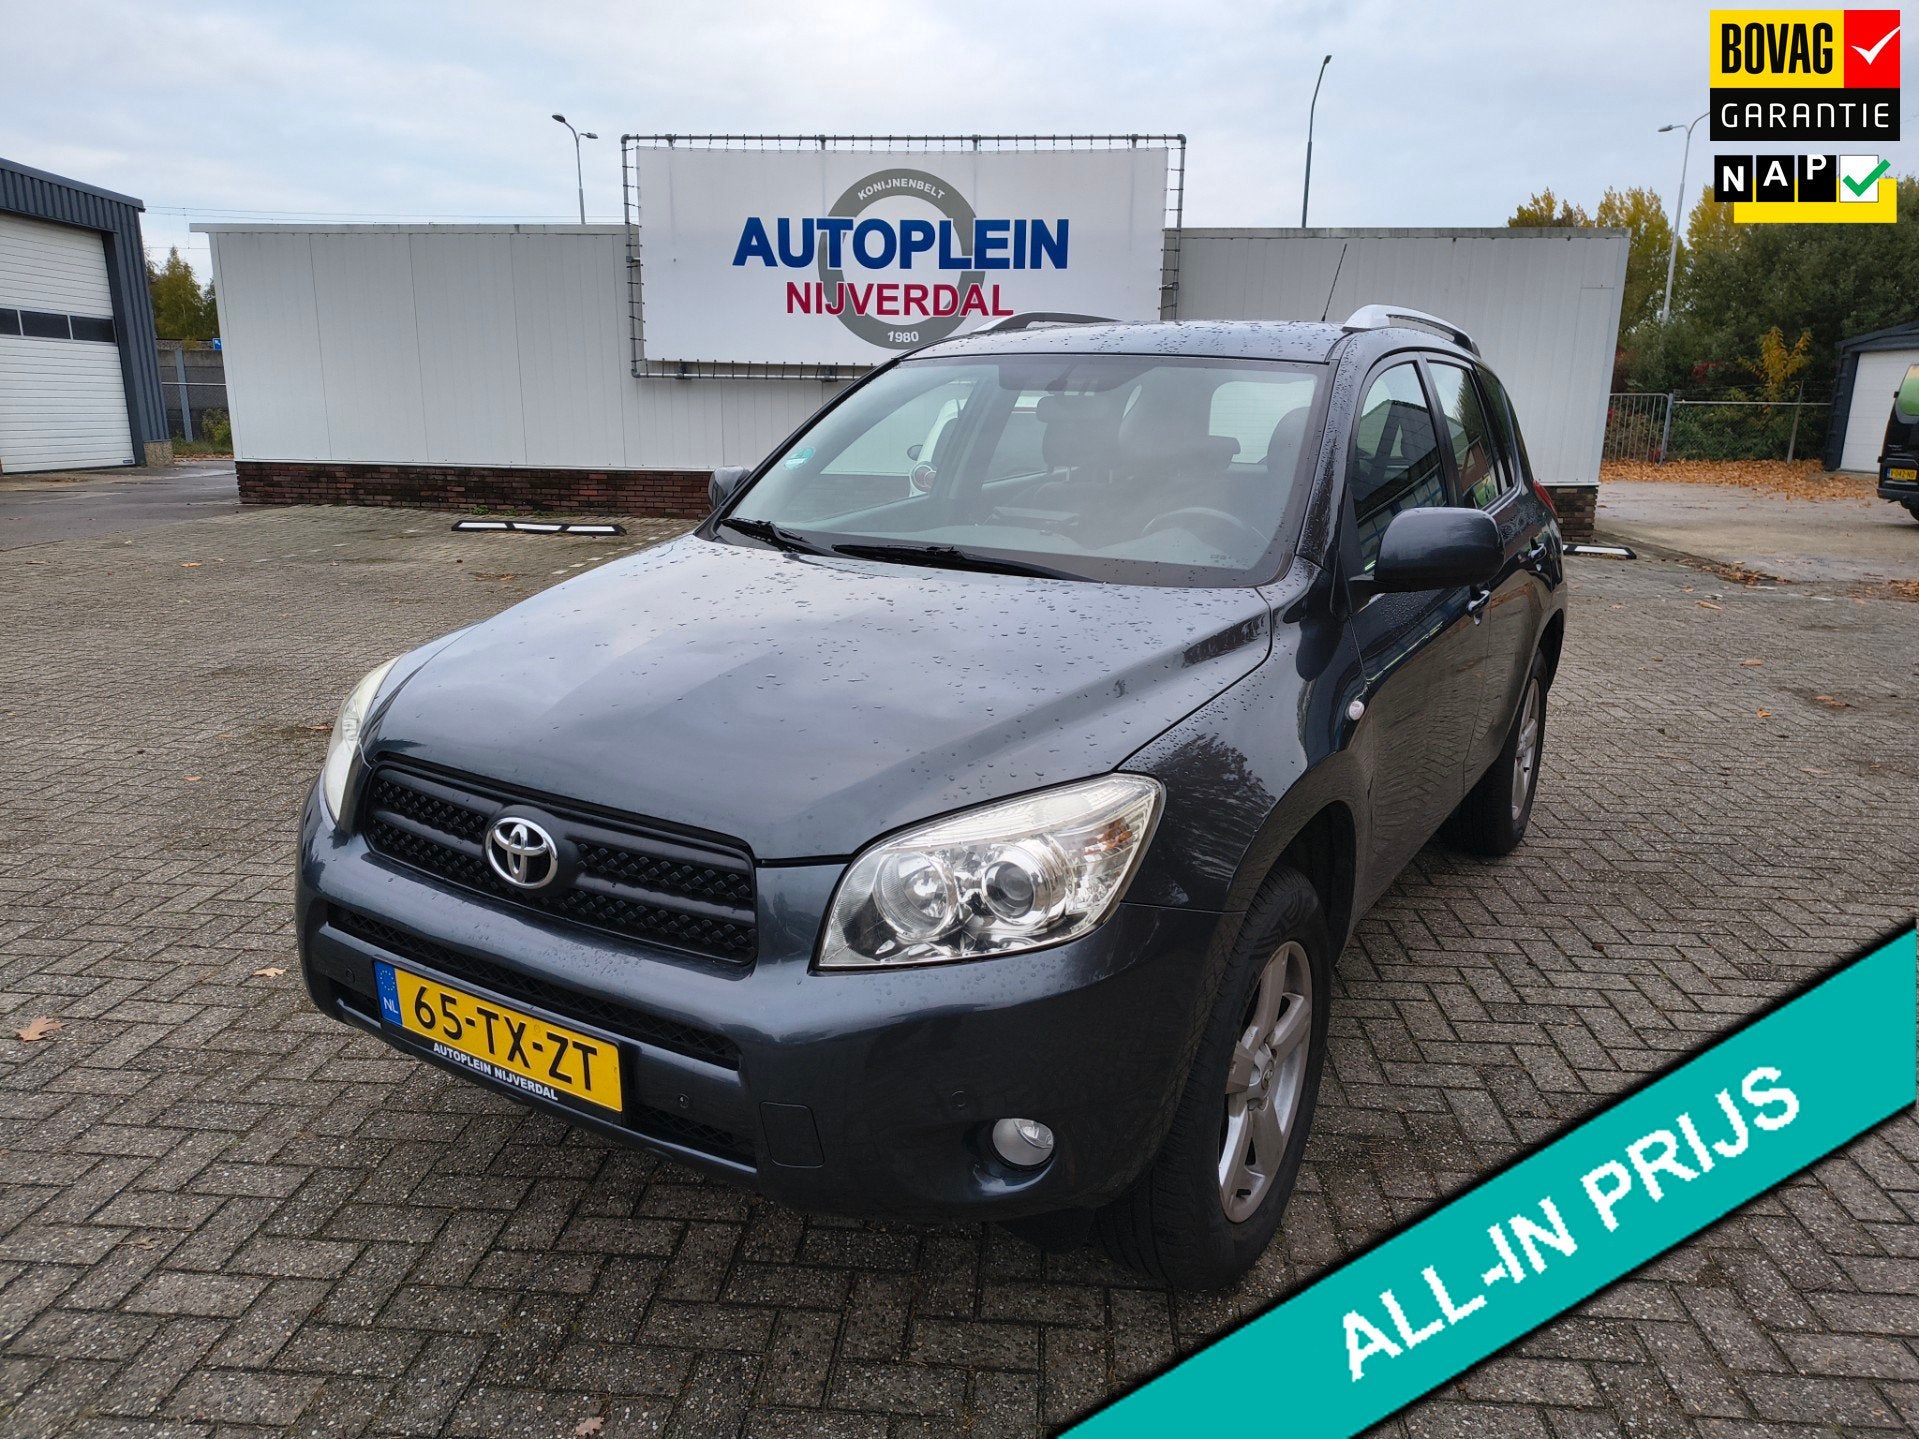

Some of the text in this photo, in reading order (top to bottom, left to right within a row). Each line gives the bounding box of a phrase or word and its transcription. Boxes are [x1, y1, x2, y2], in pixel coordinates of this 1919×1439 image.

[857, 178, 945, 200] KONIJNENBELT
[732, 217, 1070, 269] AUTOPLEIN
[785, 281, 1014, 317] NIJVERDAL
[887, 331, 919, 343] 1980
[383, 996, 399, 1015] NL
[414, 986, 598, 1092] 65-TX-ZT
[433, 1042, 559, 1101] AUTOPLEIN NIJVERDAL
